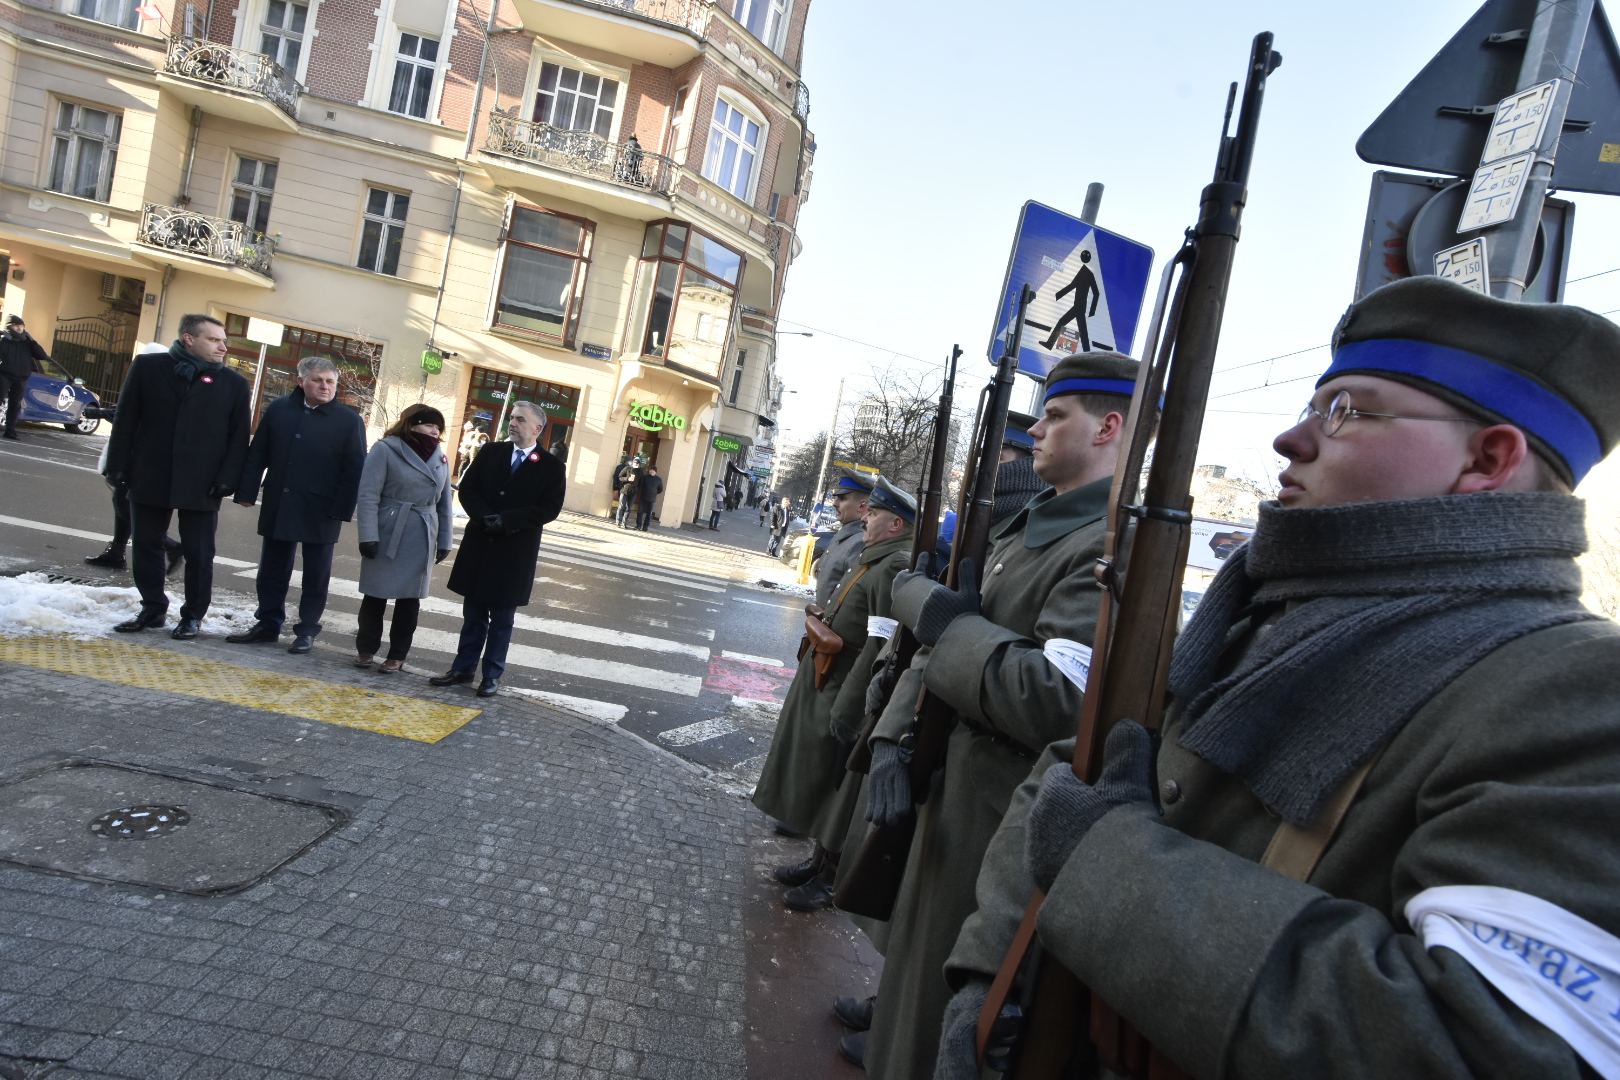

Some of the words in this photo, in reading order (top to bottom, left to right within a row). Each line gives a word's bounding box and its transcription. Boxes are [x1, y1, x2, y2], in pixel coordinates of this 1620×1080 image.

[1495, 103, 1516, 126] Z
[1525, 103, 1545, 119] 150
[1473, 172, 1492, 193] Z
[1501, 175, 1519, 189] 150
[1437, 258, 1452, 278] Z
[1465, 261, 1480, 275] 150
[629, 398, 686, 430] żabka
[714, 438, 739, 450] żabka
